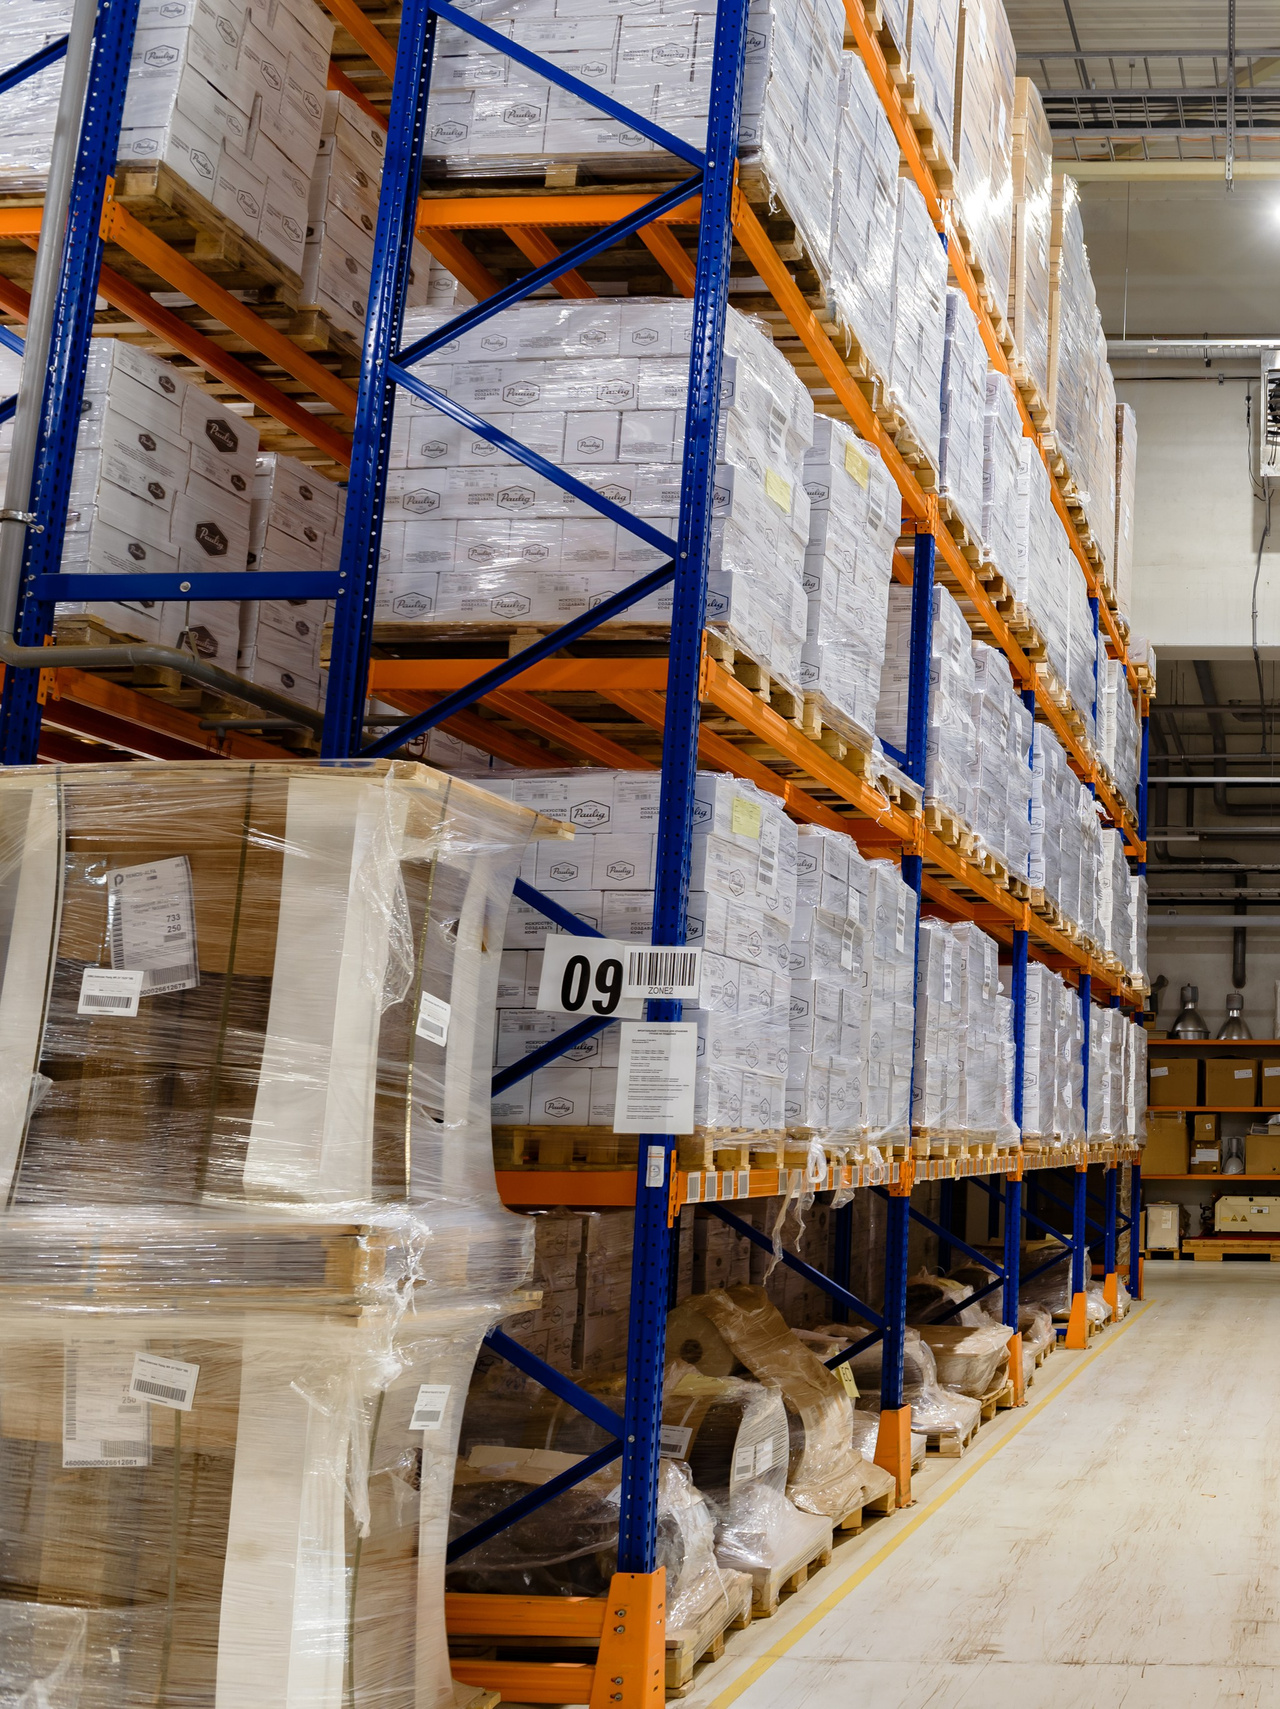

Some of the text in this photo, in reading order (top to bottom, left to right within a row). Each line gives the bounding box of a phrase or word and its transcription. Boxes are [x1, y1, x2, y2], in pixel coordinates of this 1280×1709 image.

[148, 50, 175, 62] Paulig
[584, 65, 605, 74] Paulig
[507, 109, 538, 122] Paulig
[434, 128, 464, 140] Paulig
[192, 157, 212, 175] Paulig
[484, 338, 504, 347] Paulig
[635, 333, 655, 341] Paulig
[210, 423, 234, 448] Paulig
[424, 445, 444, 454] Paulig
[580, 441, 600, 450] Paulig
[406, 496, 436, 508] Paulig
[501, 493, 531, 505] Paulig
[200, 528, 224, 550] Paulig
[396, 599, 428, 611] Paulig
[495, 599, 526, 612] Paulig
[574, 809, 606, 820] Paulig
[554, 867, 574, 877] Paulig
[610, 866, 631, 876] Paulig
[166, 913, 180, 922] 733
[167, 924, 181, 933] 250
[561, 955, 623, 1015] 09
[648, 987, 673, 995] ZONE2
[548, 1103, 571, 1112] Paulig
